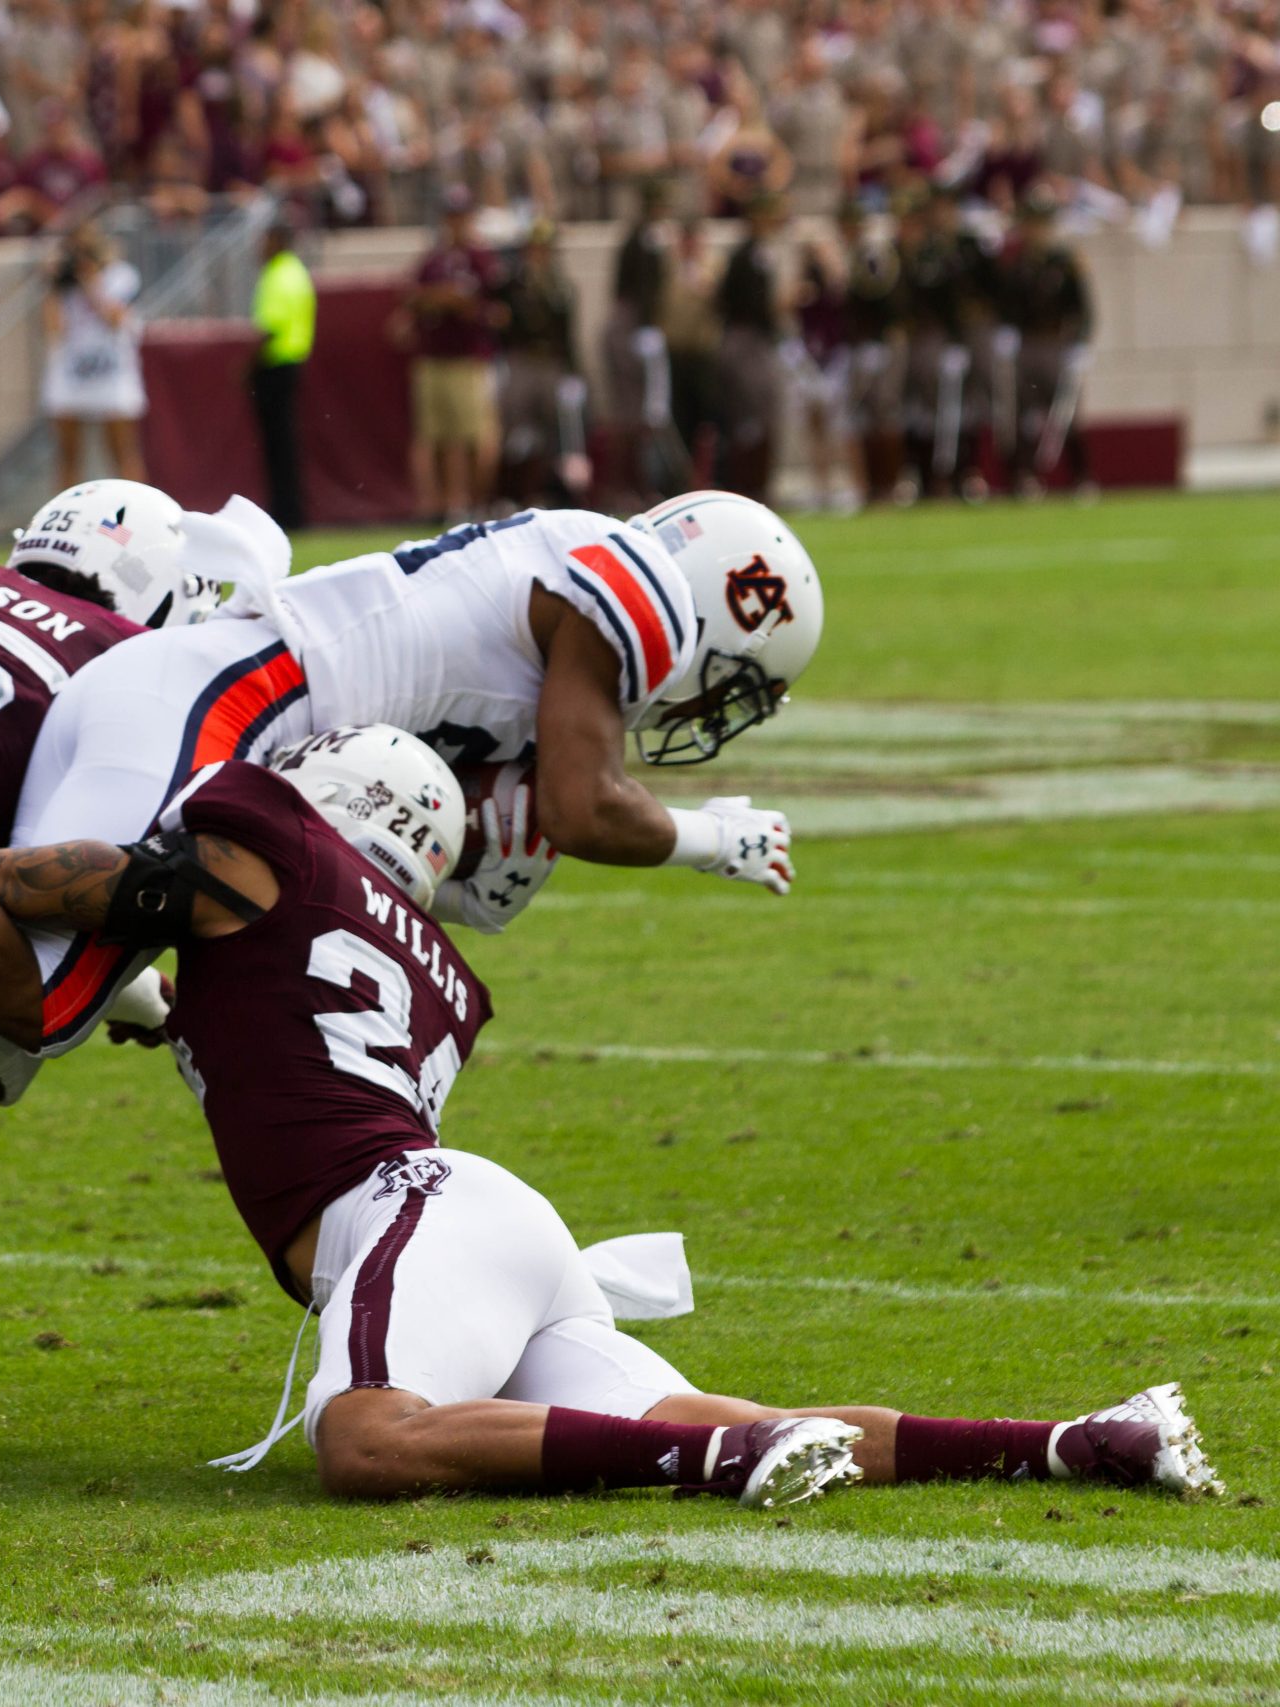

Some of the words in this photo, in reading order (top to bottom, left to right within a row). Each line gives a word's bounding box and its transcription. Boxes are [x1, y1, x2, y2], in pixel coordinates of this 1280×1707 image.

[41, 510, 80, 532] 25
[387, 805, 431, 853] 24
[369, 841, 398, 869] TEXAS
[395, 865, 414, 886] A&M
[361, 876, 468, 1023] WILLIS
